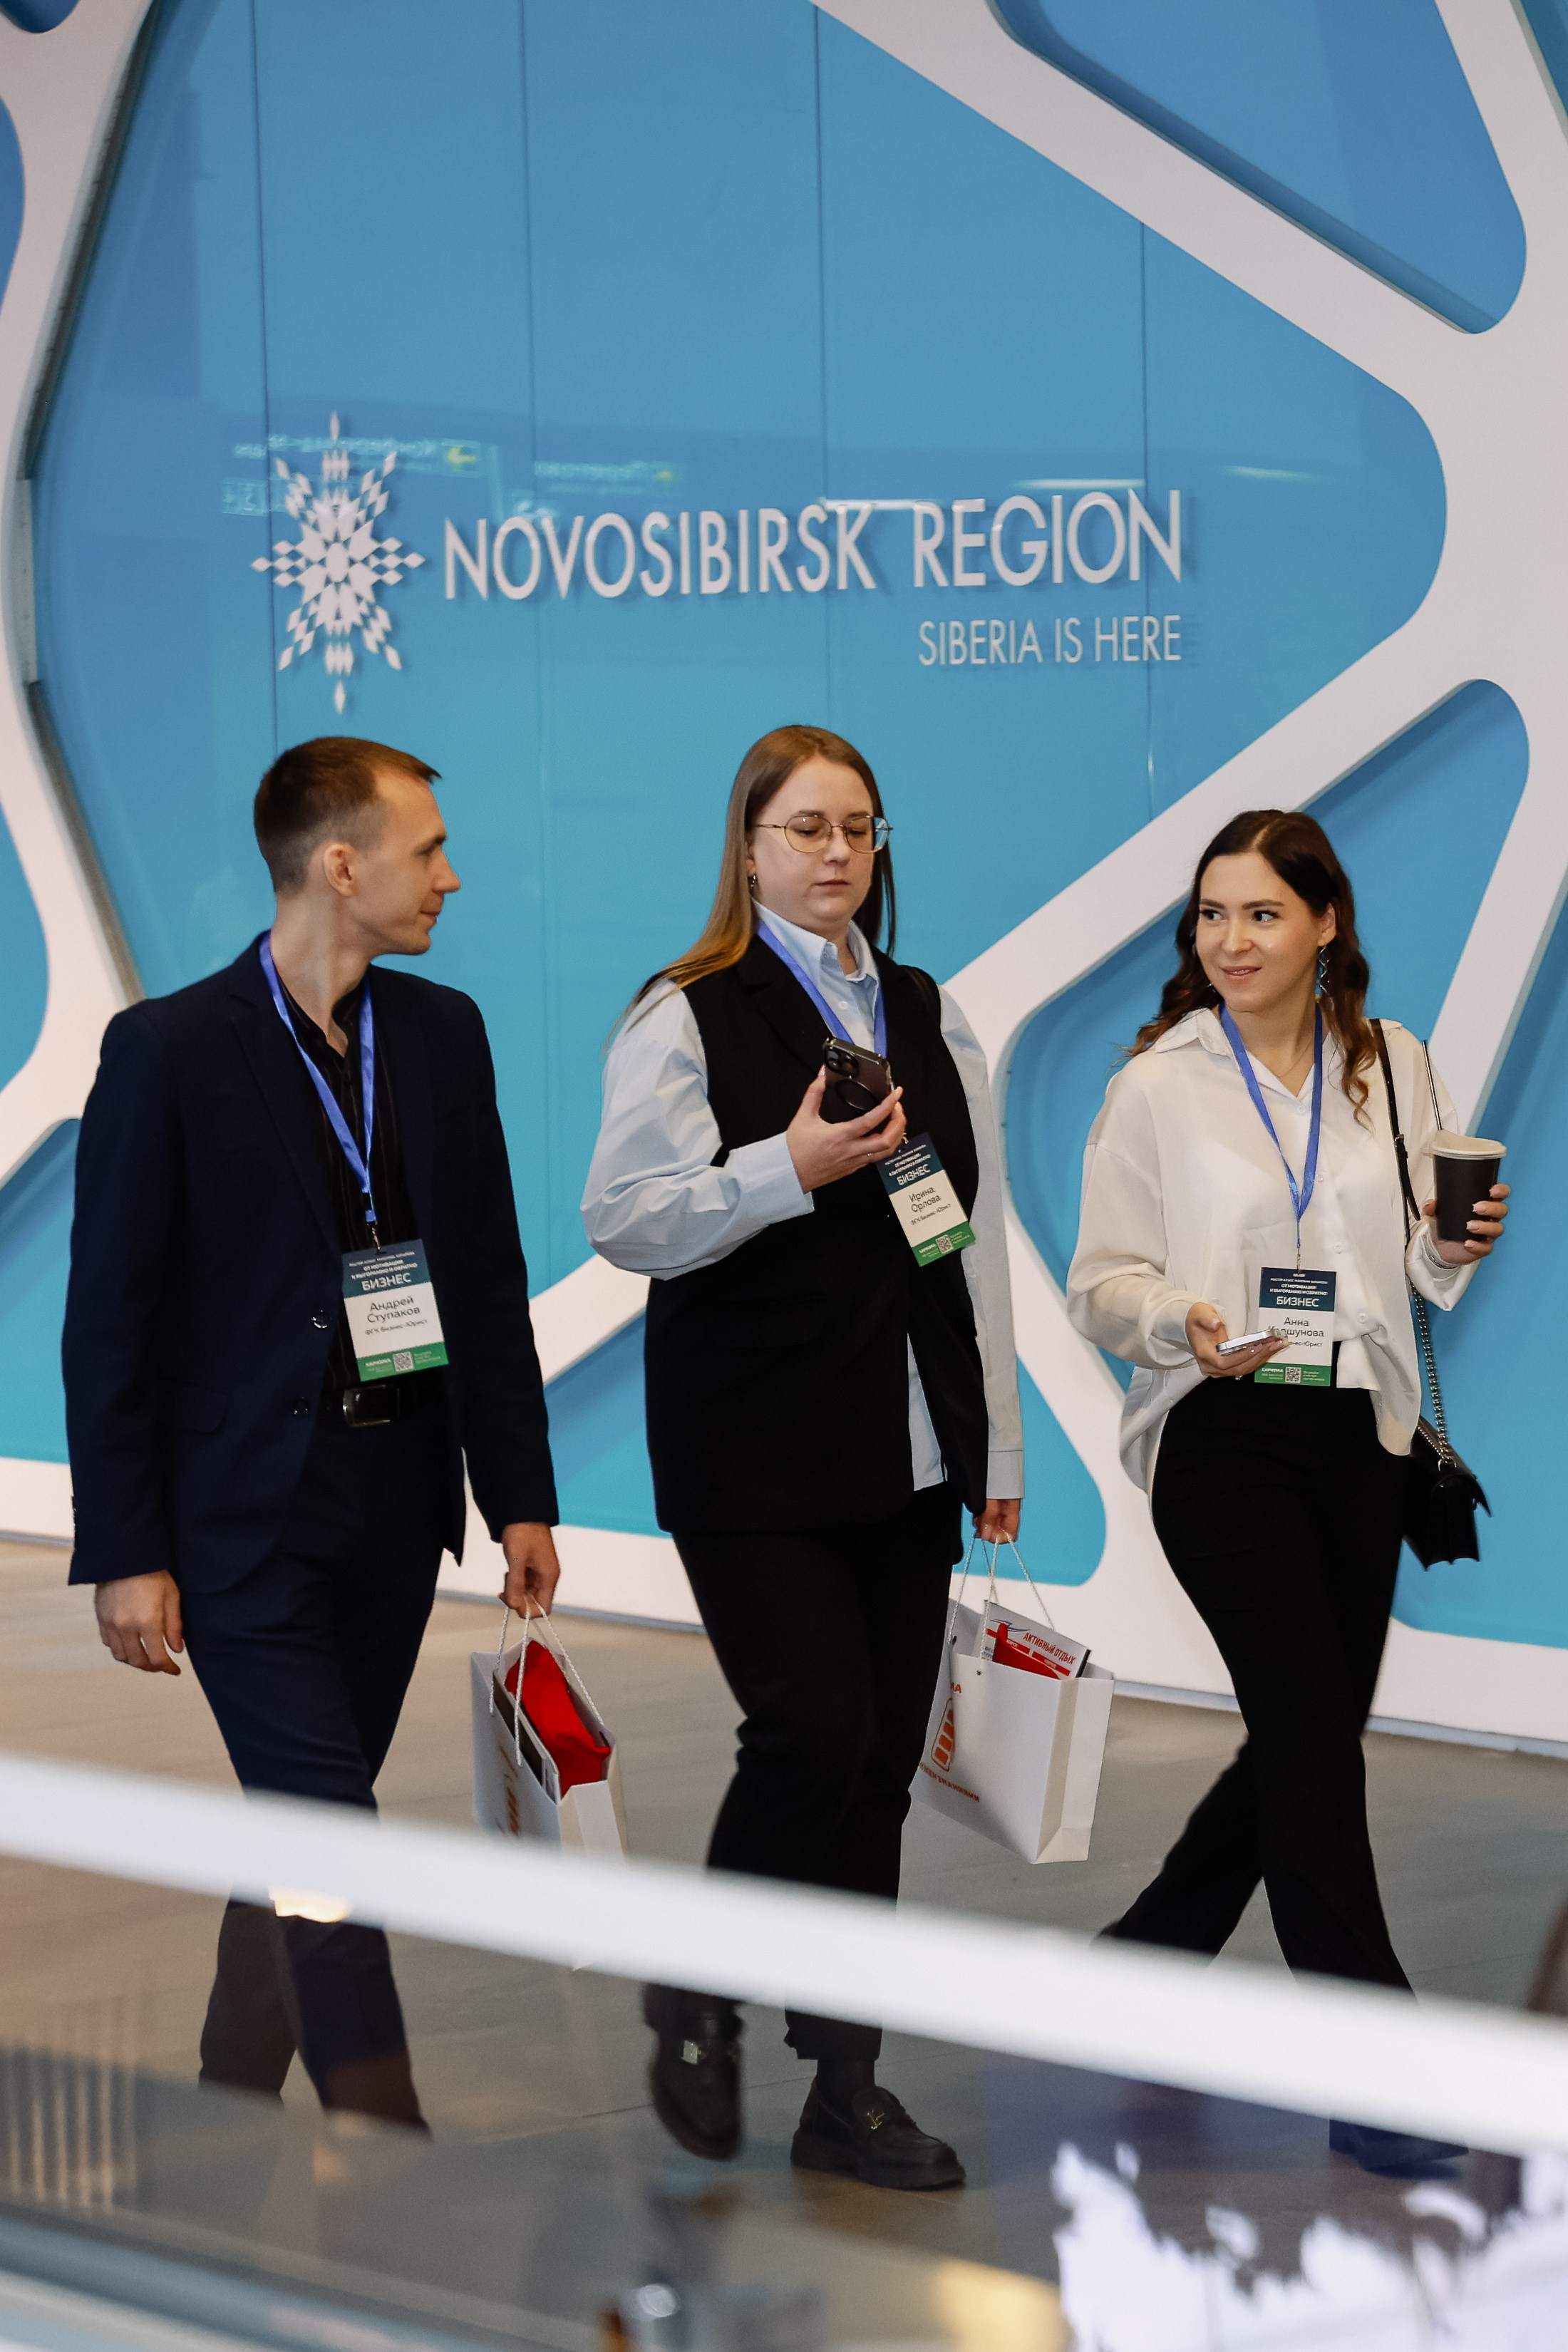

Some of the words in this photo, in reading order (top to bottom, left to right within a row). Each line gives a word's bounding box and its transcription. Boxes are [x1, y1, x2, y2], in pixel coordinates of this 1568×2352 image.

[444, 503, 877, 601] NOVOSIBIRSK
[912, 488, 1182, 588] REGION
[918, 619, 1044, 666] SIBERIA
[1055, 617, 1083, 664] IS
[1095, 614, 1182, 662] HERE
[897, 1164, 931, 1186] БИЗНЕС
[909, 1186, 935, 1203] Ирина
[911, 1195, 941, 1212] Орлова
[361, 1272, 412, 1291] БИЗНЕС
[370, 1296, 414, 1312] Андрей
[1276, 1296, 1320, 1307] БИЗНЕС
[366, 1306, 421, 1324] Ступаков
[1284, 1317, 1310, 1326] Анна
[1268, 1326, 1324, 1338] Кшунова
[1023, 1632, 1056, 1654] АКТИВНЫЙ
[1053, 1648, 1076, 1665] ОТДЫХ
